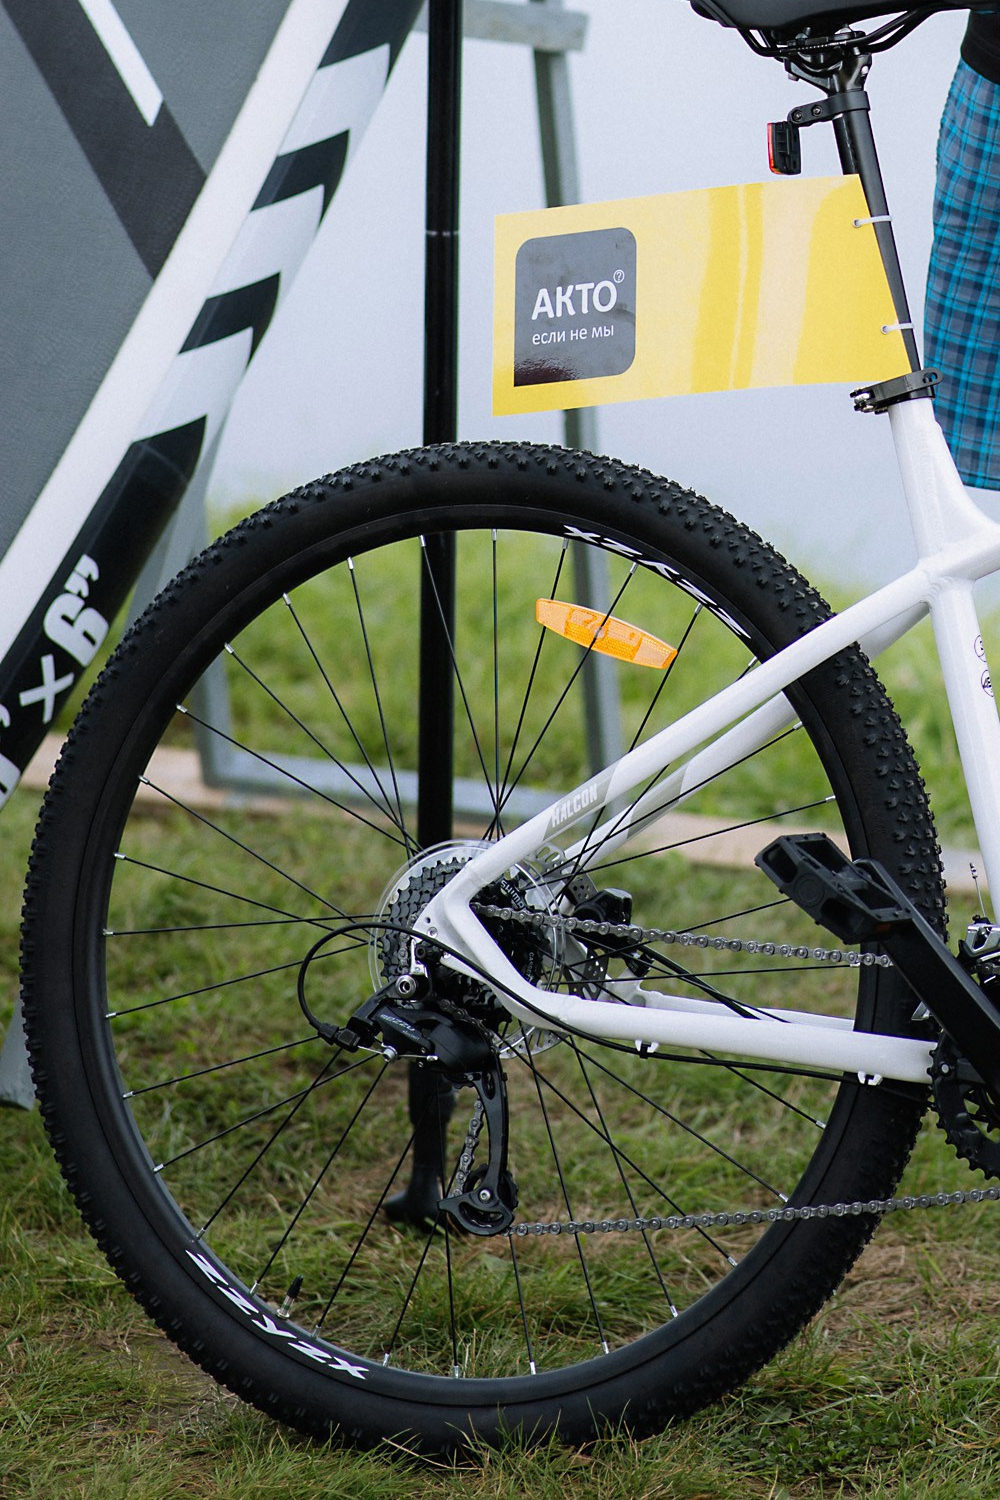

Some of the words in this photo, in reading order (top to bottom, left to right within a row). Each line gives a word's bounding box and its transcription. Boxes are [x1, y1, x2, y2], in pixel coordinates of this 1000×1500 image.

[531, 280, 618, 321] АКТО
[532, 330, 566, 345] если
[570, 328, 588, 341] не
[591, 325, 614, 339] мы
[184, 1249, 370, 1380] ZZYZX
